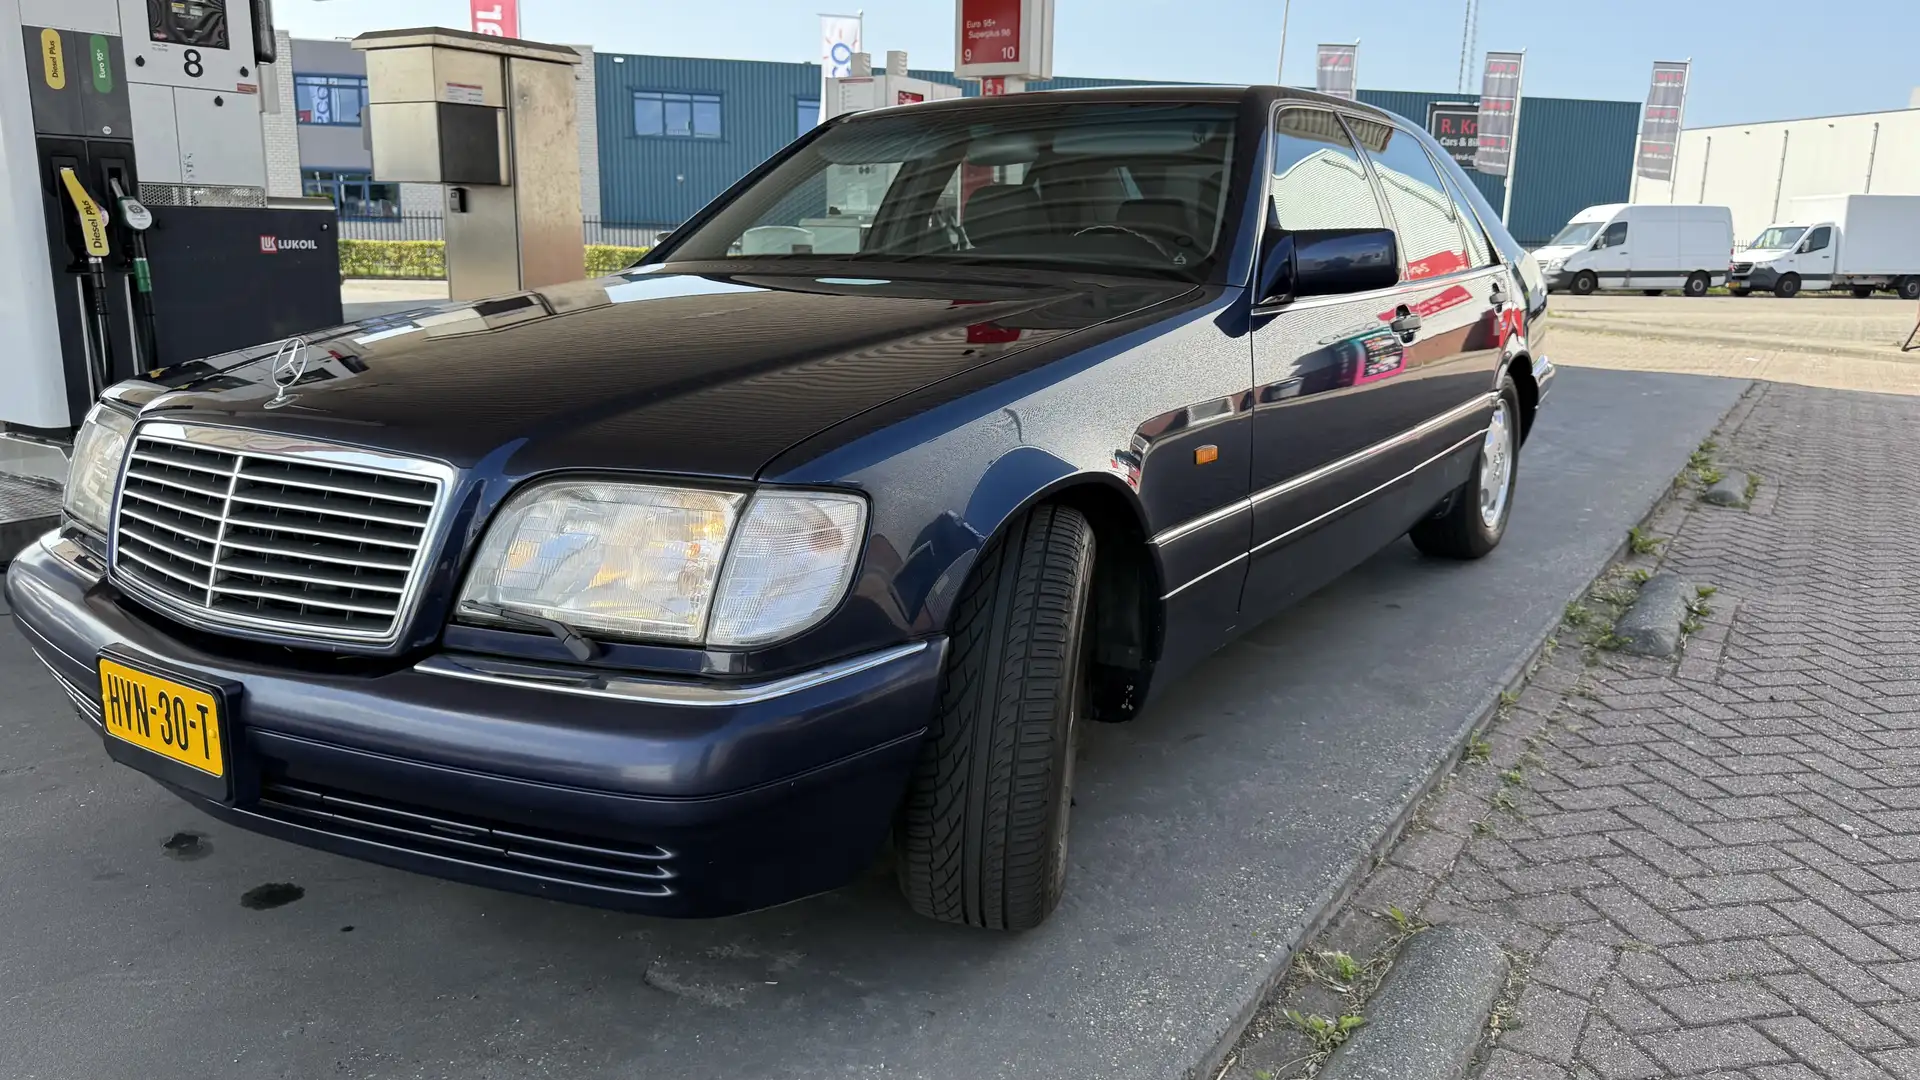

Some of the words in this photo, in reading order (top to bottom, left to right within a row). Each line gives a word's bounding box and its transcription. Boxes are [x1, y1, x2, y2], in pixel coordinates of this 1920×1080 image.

[966, 20, 981, 29] Euro
[968, 29, 1000, 39] Superplus
[96, 49, 104, 62] 95+
[964, 48, 972, 61] 9
[1001, 46, 1015, 59] 10
[184, 49, 204, 78] 8
[1441, 118, 1456, 134] R.
[1440, 136, 1458, 147] Cars
[1458, 137, 1467, 147] &
[88, 218, 103, 249] Diesel
[278, 239, 318, 249] LUKOIL
[107, 673, 210, 760] HVN-30-T
